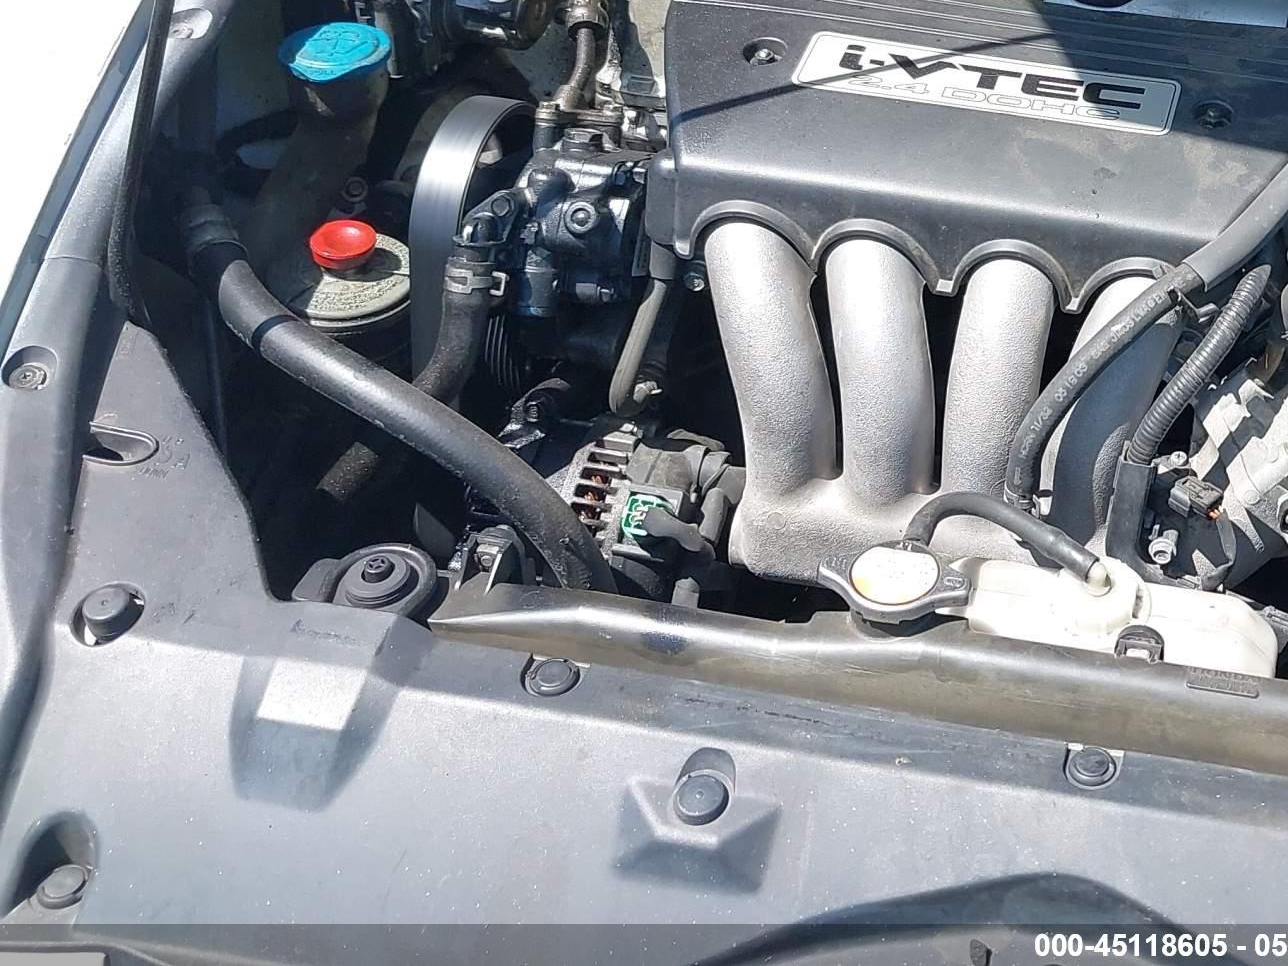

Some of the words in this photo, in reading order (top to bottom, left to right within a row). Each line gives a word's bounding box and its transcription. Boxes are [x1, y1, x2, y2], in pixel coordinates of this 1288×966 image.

[838, 44, 1146, 111] i-VTEC
[847, 75, 930, 95] 2.4
[940, 87, 1121, 122] DOHC
